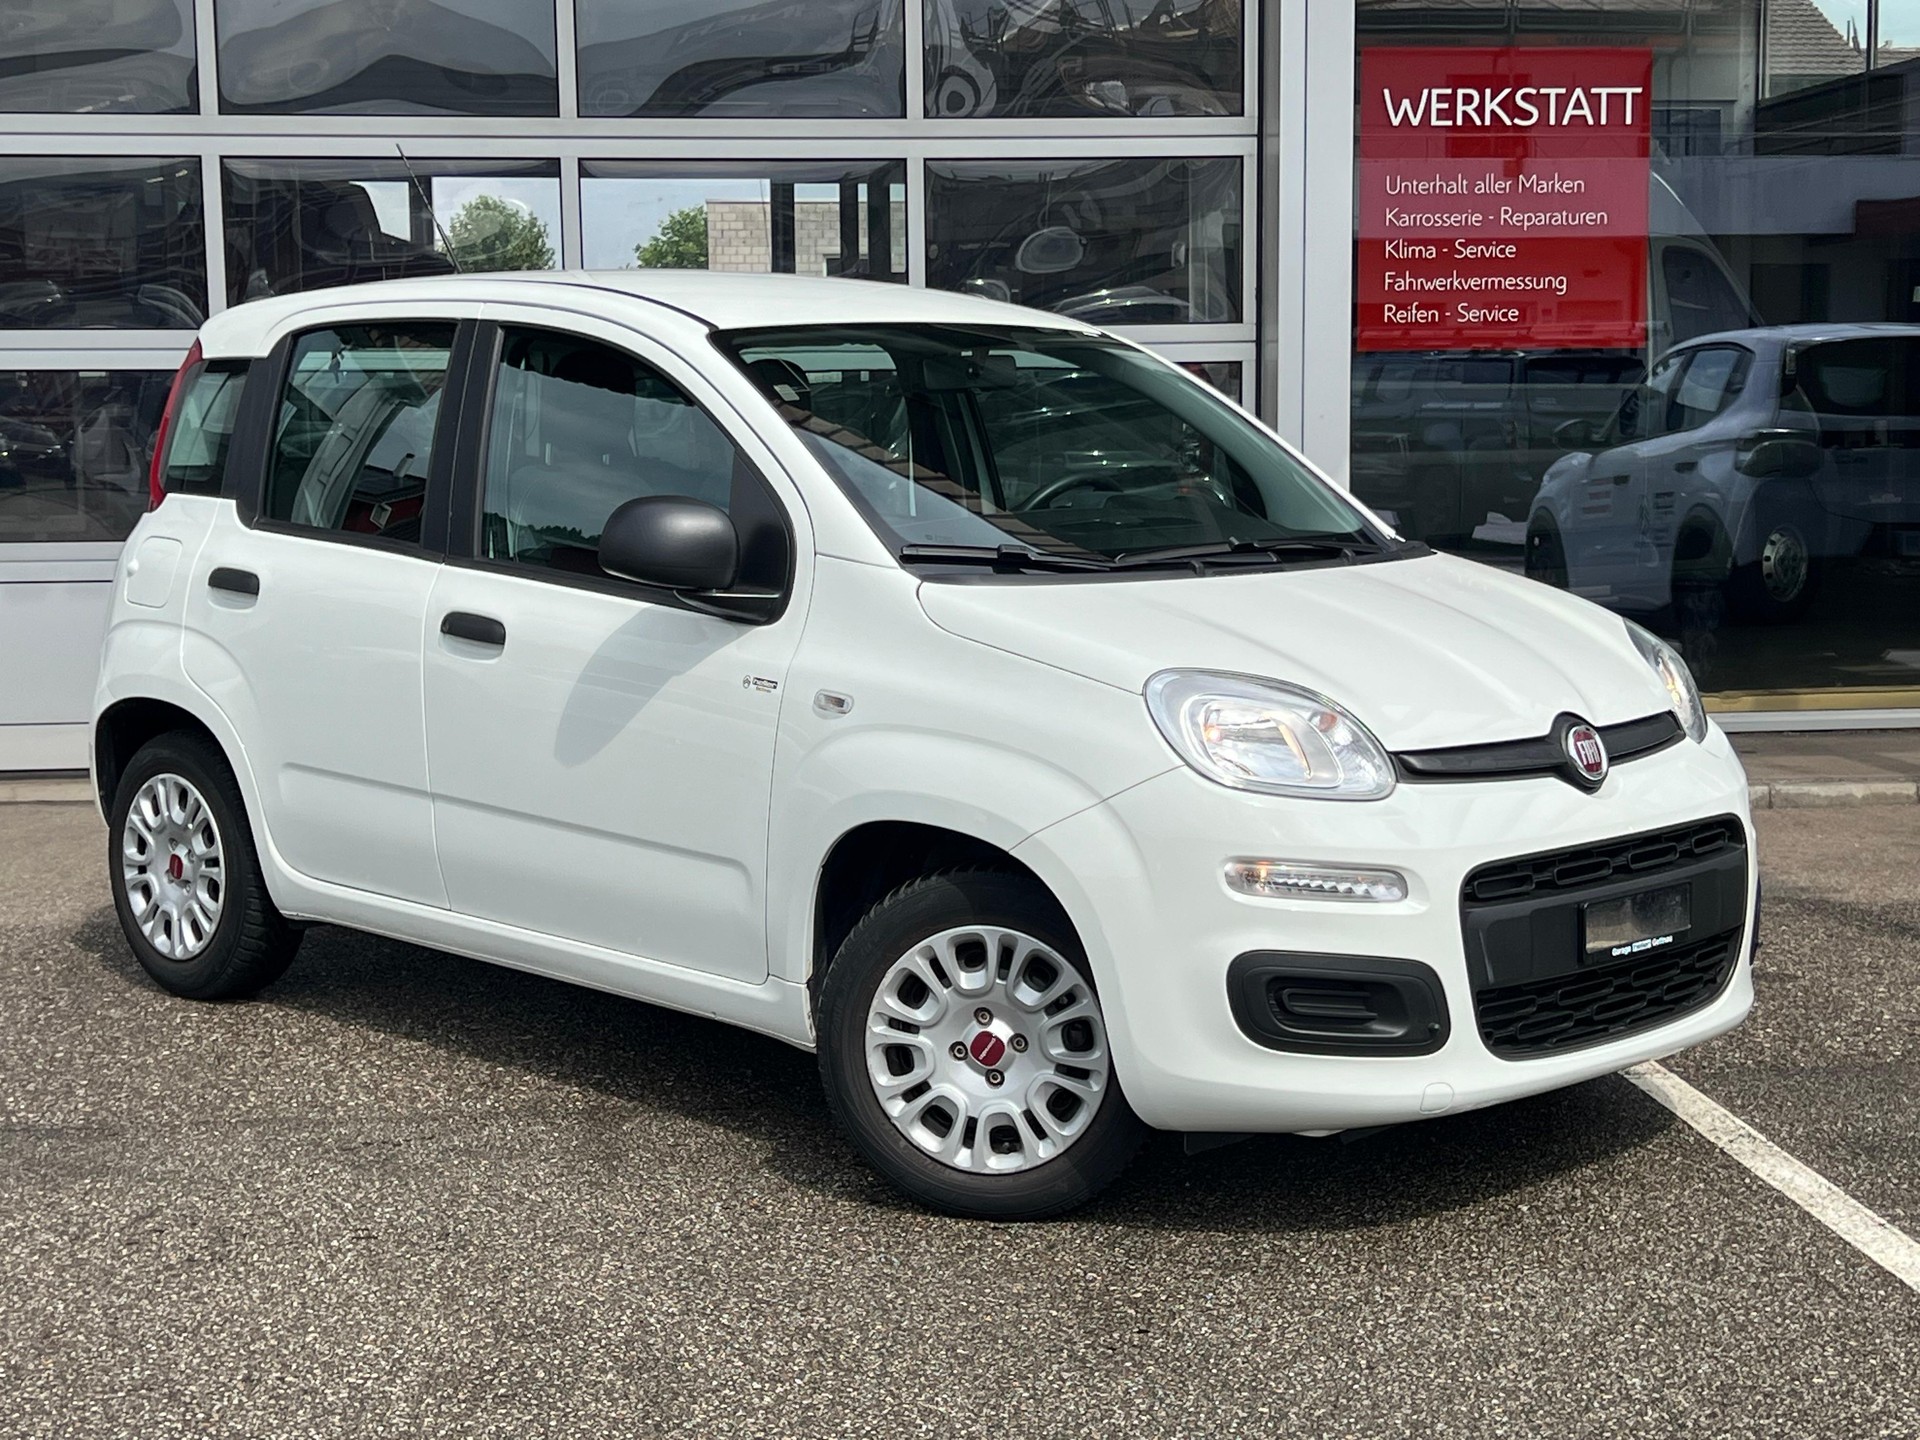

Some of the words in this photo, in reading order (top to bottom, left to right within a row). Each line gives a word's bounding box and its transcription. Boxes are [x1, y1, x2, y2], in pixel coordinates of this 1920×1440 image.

[1383, 86, 1643, 127] WERKSTATT
[1386, 173, 1468, 195] Unterhalt
[1474, 173, 1512, 194] aller
[1518, 172, 1585, 194] Marken
[1385, 207, 1483, 228] Karrosserie
[1500, 206, 1608, 231] Reparaturen
[1385, 238, 1436, 259] Klima
[1454, 238, 1517, 259] Service
[1384, 269, 1567, 295] Fahrwerkvermessung
[1384, 301, 1439, 324] Reifen
[1457, 302, 1519, 323] Service
[1576, 739, 1600, 765] FIAT
